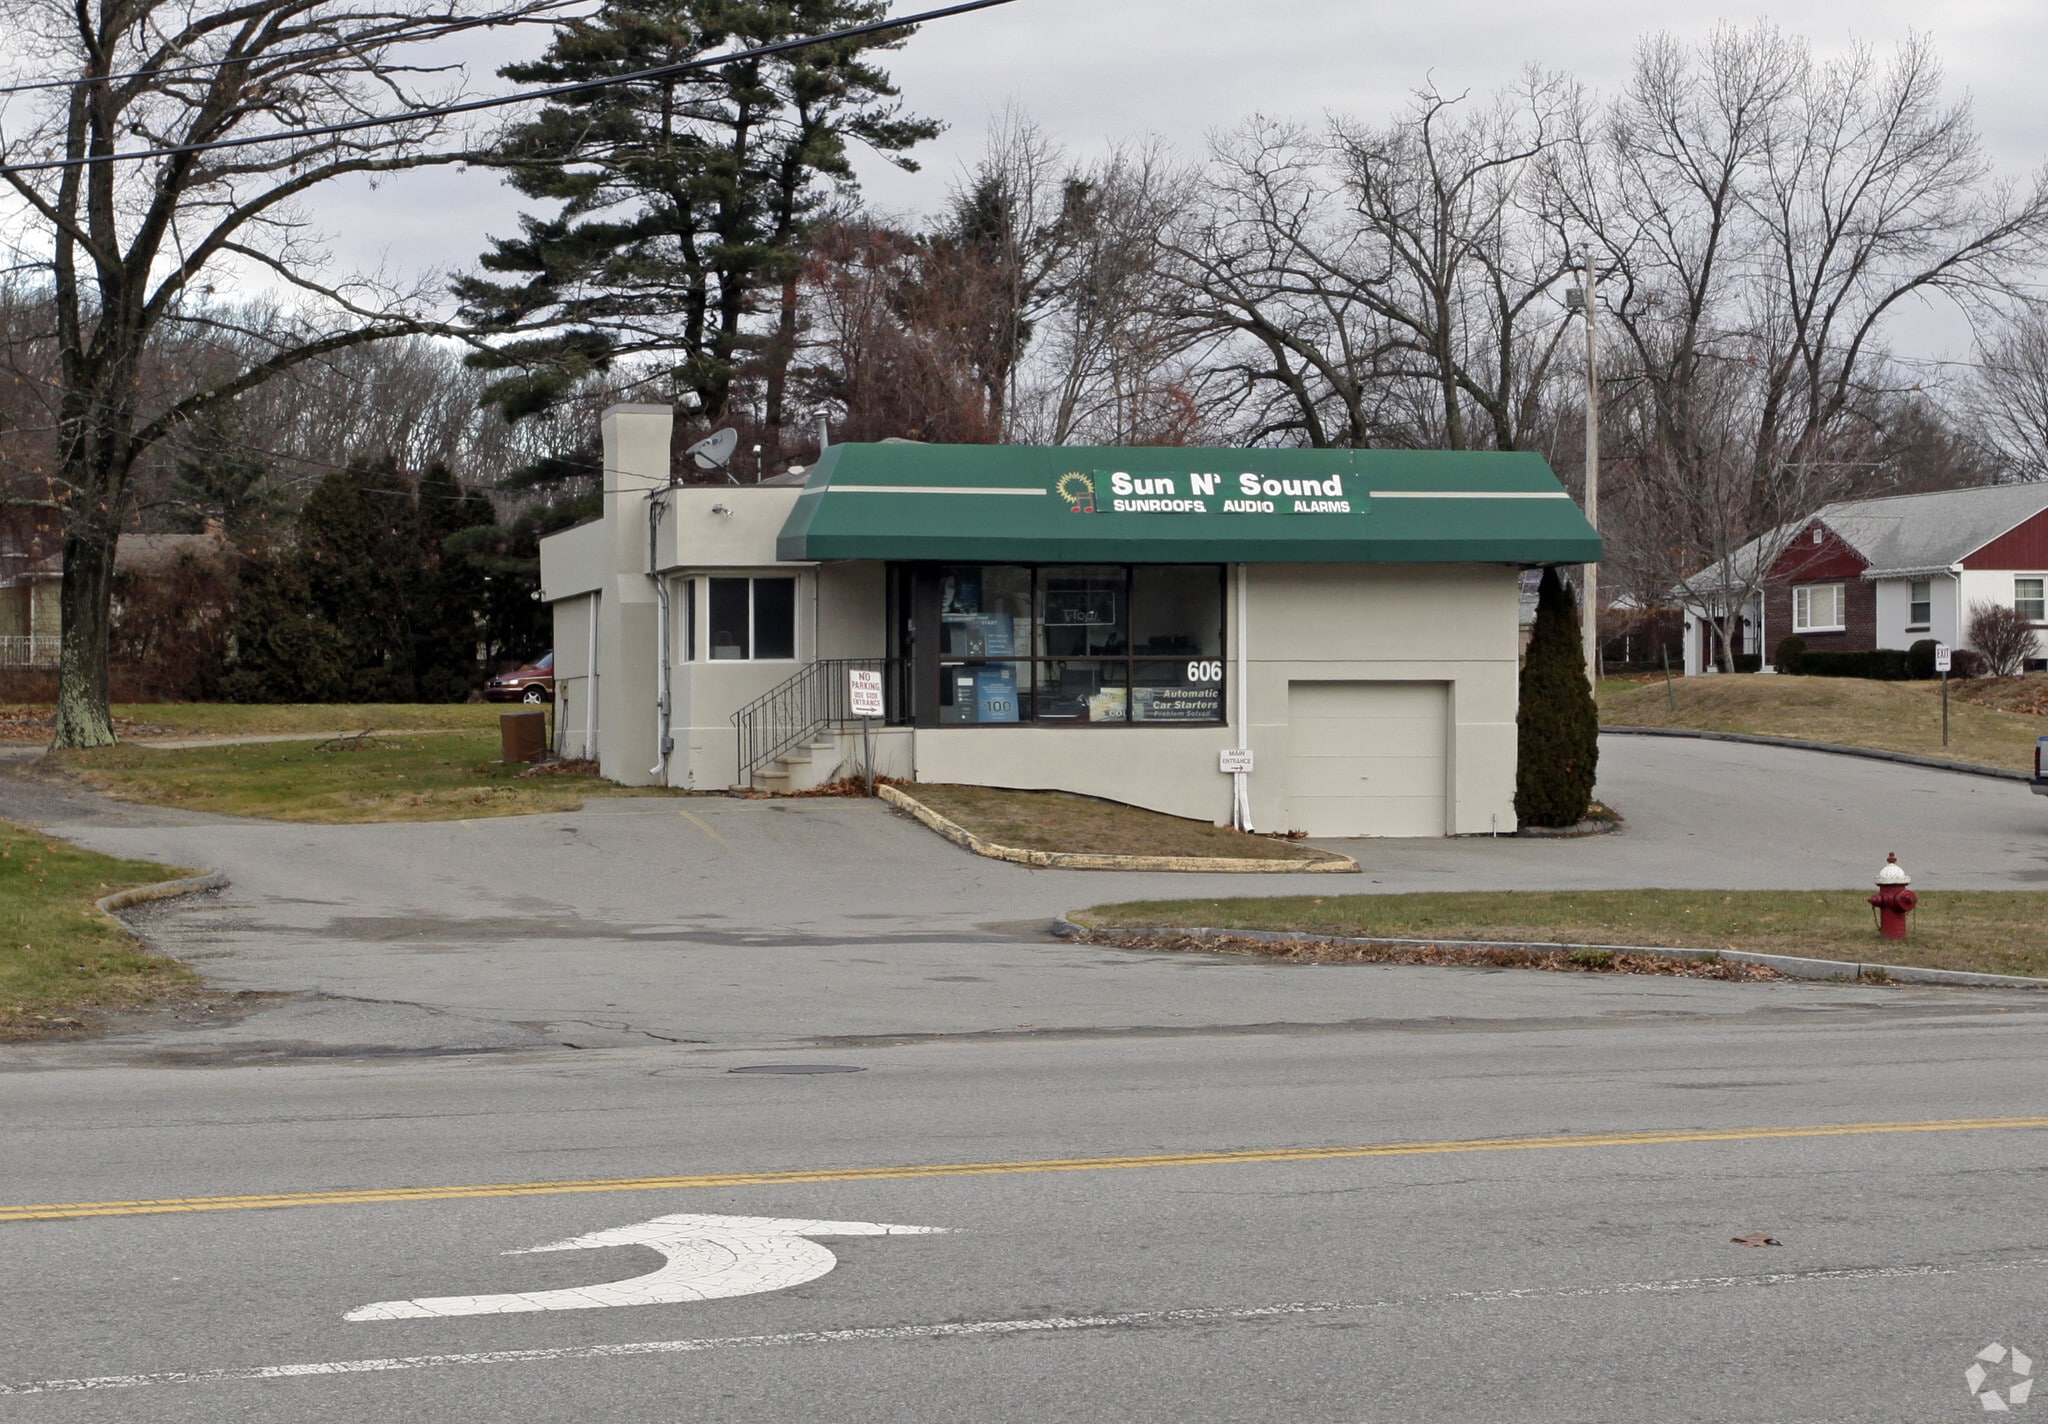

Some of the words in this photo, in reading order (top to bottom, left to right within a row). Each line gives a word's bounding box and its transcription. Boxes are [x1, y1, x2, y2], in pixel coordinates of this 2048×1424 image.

[1111, 472, 1175, 495] Sun
[1190, 473, 1221, 495] N'
[1239, 473, 1343, 496] Sound
[1223, 500, 1274, 513] AUDIO
[1294, 501, 1350, 513] ALARMS
[1937, 648, 1949, 658] EXIT
[1187, 661, 1222, 681] 606
[859, 672, 871, 681] NO
[852, 680, 880, 690] PARKING
[1163, 689, 1219, 698] Automatic
[853, 698, 880, 706] ENTRANCE
[1153, 701, 1171, 709] Car
[1174, 700, 1218, 709] Starters
